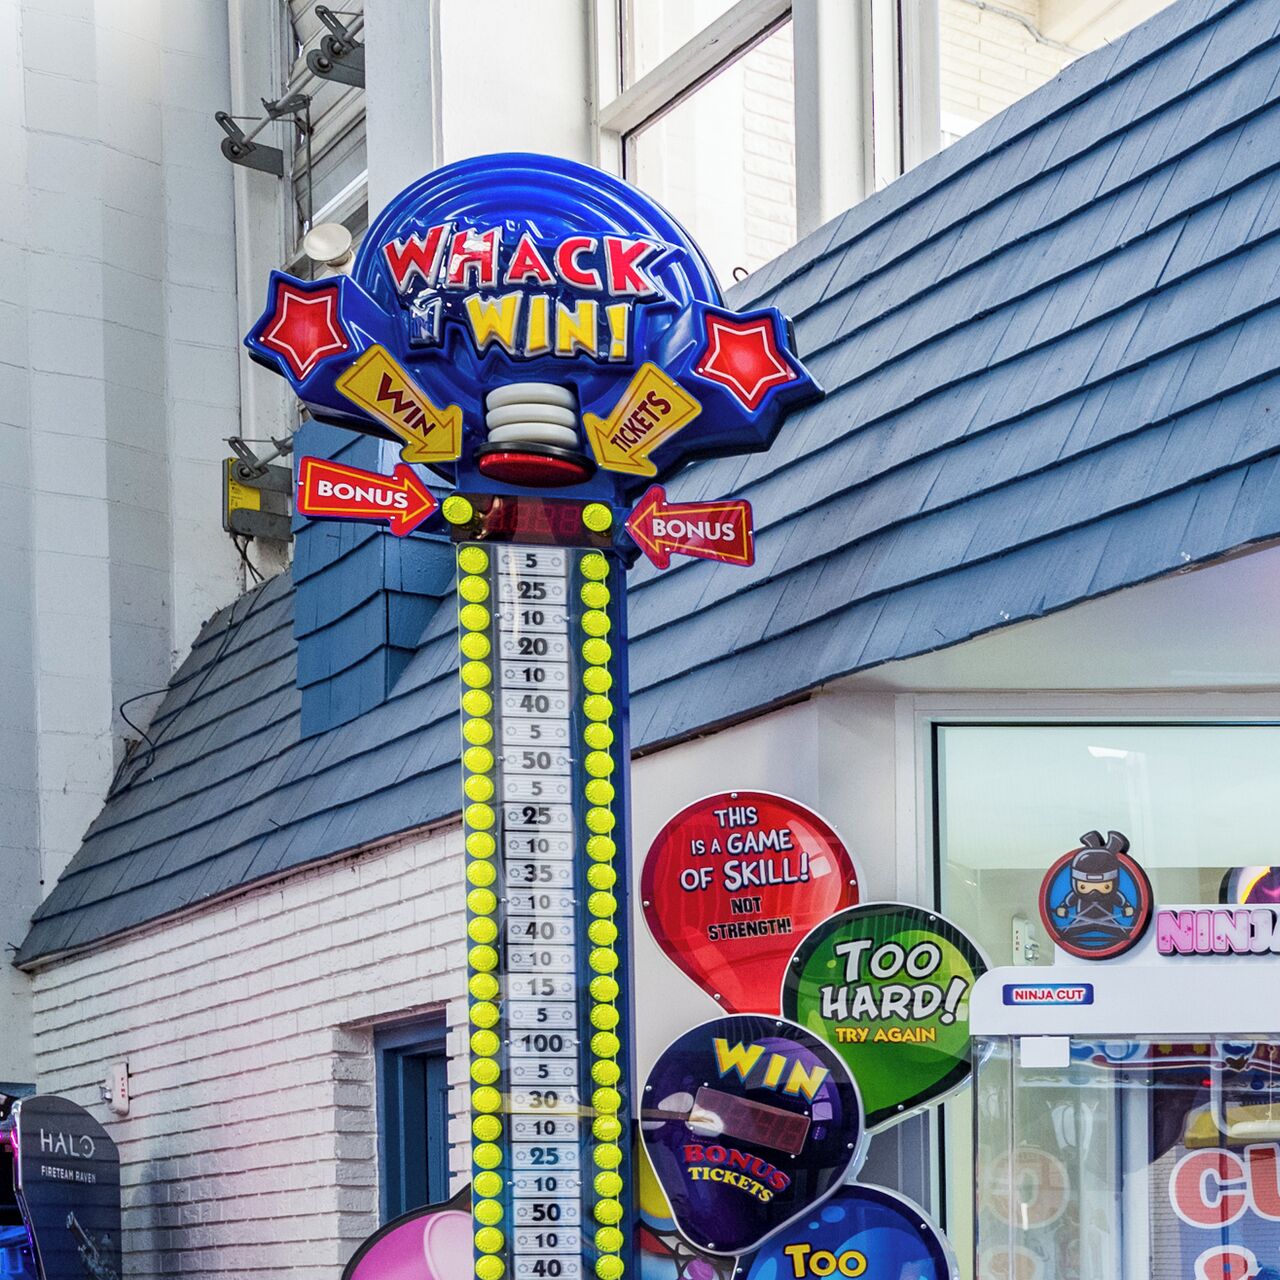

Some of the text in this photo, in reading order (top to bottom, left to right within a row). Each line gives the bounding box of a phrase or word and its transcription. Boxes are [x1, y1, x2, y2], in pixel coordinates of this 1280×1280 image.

[383, 222, 657, 297] WHACK
[464, 291, 629, 362] WIN!
[375, 372, 436, 437] WIN
[610, 390, 672, 453] TICKETS
[317, 480, 409, 511] BONUS
[652, 519, 735, 541] BONUS
[525, 554, 537, 568] 5
[516, 581, 547, 599] 25
[521, 611, 544, 625] 10
[518, 638, 548, 655] 20
[522, 667, 545, 682] 10
[520, 695, 549, 713] 40
[530, 725, 541, 739] 5
[522, 752, 551, 770] 50
[531, 781, 542, 795] 5
[522, 807, 551, 825] 25
[714, 806, 758, 828] THIS
[526, 838, 549, 853] 10
[691, 829, 793, 855] IS A GAME
[524, 864, 553, 882] 35
[680, 852, 809, 892] OF SKILL!
[528, 895, 550, 910] 10
[730, 896, 761, 915] NOT
[525, 922, 554, 940] 40
[708, 918, 792, 941] STRENGTH!
[529, 951, 551, 966] 10
[836, 939, 942, 983] TOO
[527, 978, 554, 996] 15
[1014, 989, 1084, 1000] NINJA CUT
[819, 976, 969, 1025] HARD!
[537, 1008, 547, 1022] 5
[520, 1034, 563, 1052] 100
[835, 1026, 936, 1043] TRY AGAIN
[538, 1064, 549, 1078] 5
[713, 1037, 830, 1103] WIN
[529, 1090, 558, 1109] 30
[533, 1120, 556, 1135] 10
[40, 1128, 96, 1159] HALO
[530, 1147, 559, 1165] 25
[41, 1165, 97, 1184] FIRETEAM RAVEN
[682, 1144, 793, 1192] BONUS
[534, 1177, 557, 1191] 10
[688, 1166, 774, 1203] TICKETS
[532, 1204, 561, 1221] 50
[535, 1233, 558, 1248] 10
[532, 1259, 562, 1278] 40
[784, 1243, 868, 1278] TOO
